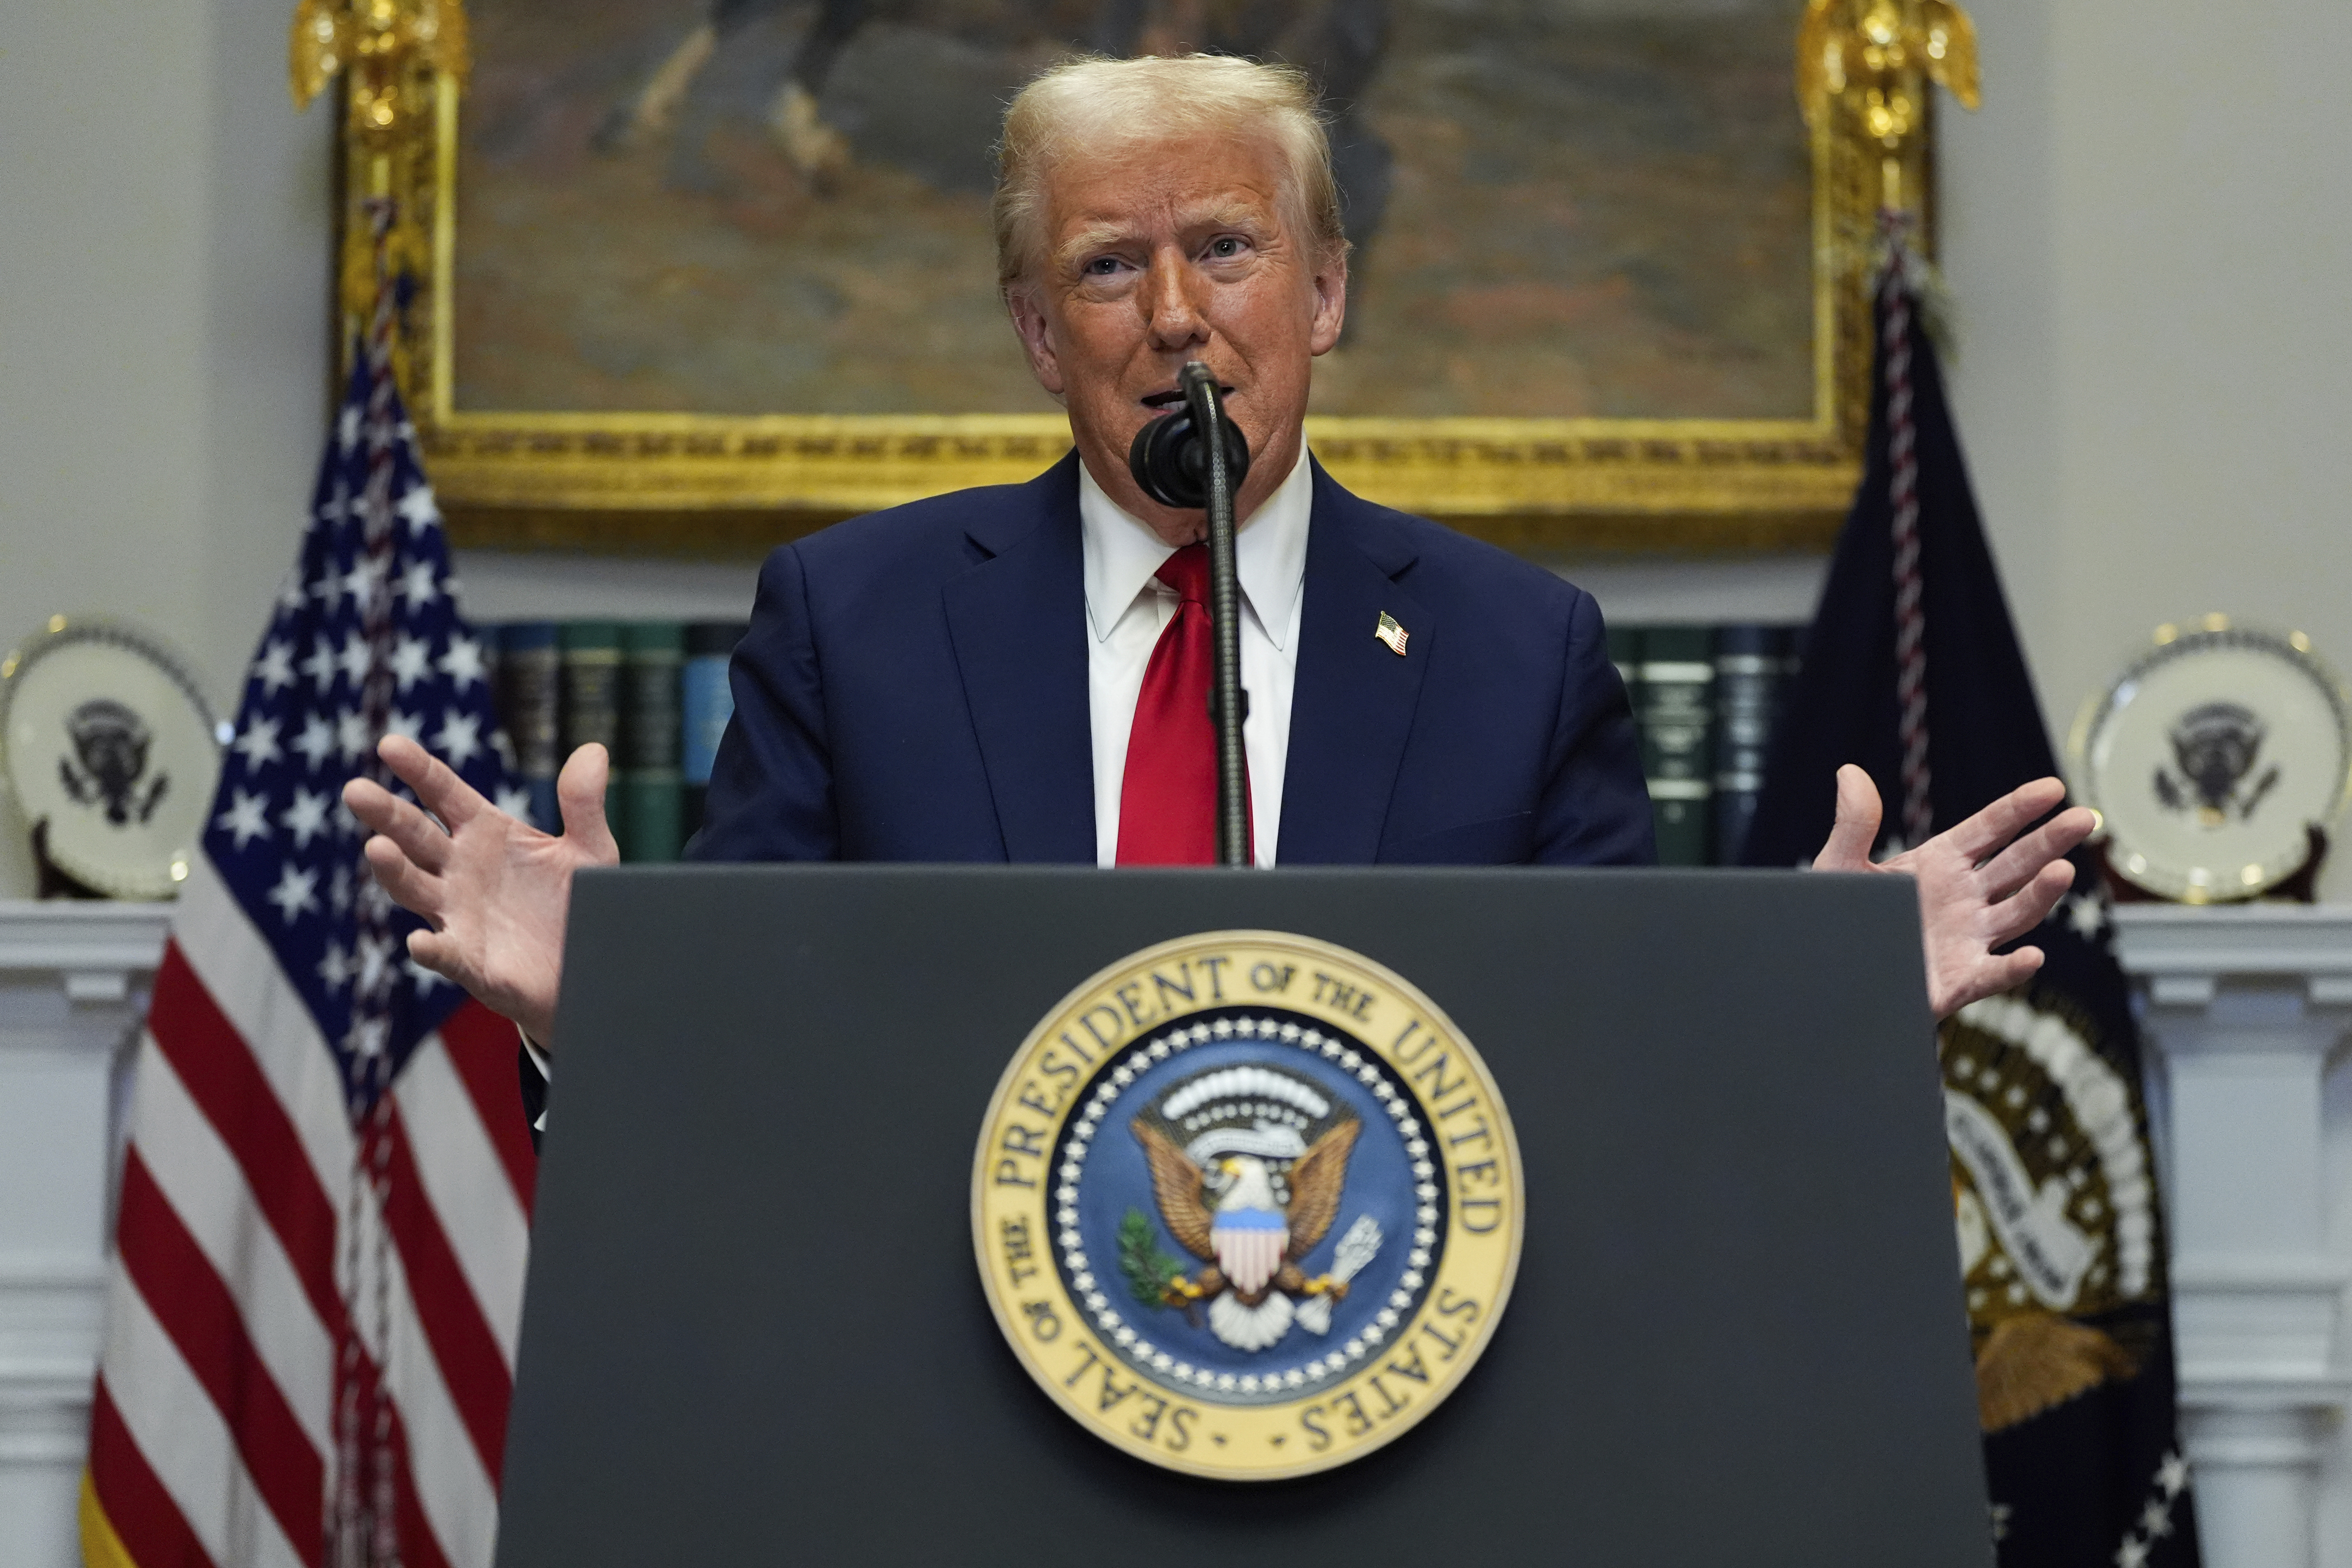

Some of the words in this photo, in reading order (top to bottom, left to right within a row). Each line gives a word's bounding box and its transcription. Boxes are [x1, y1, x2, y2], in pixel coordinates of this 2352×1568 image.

[1249, 961, 1297, 994] OF
[1312, 971, 1375, 1023] THE
[994, 954, 1230, 1191] PRESIDENT
[1388, 1017, 1503, 1237] UNITED
[999, 1214, 1039, 1290] THE
[1019, 1299, 1063, 1344] OF
[1065, 1339, 1199, 1452] SEAL
[1299, 1287, 1480, 1451] STATES
